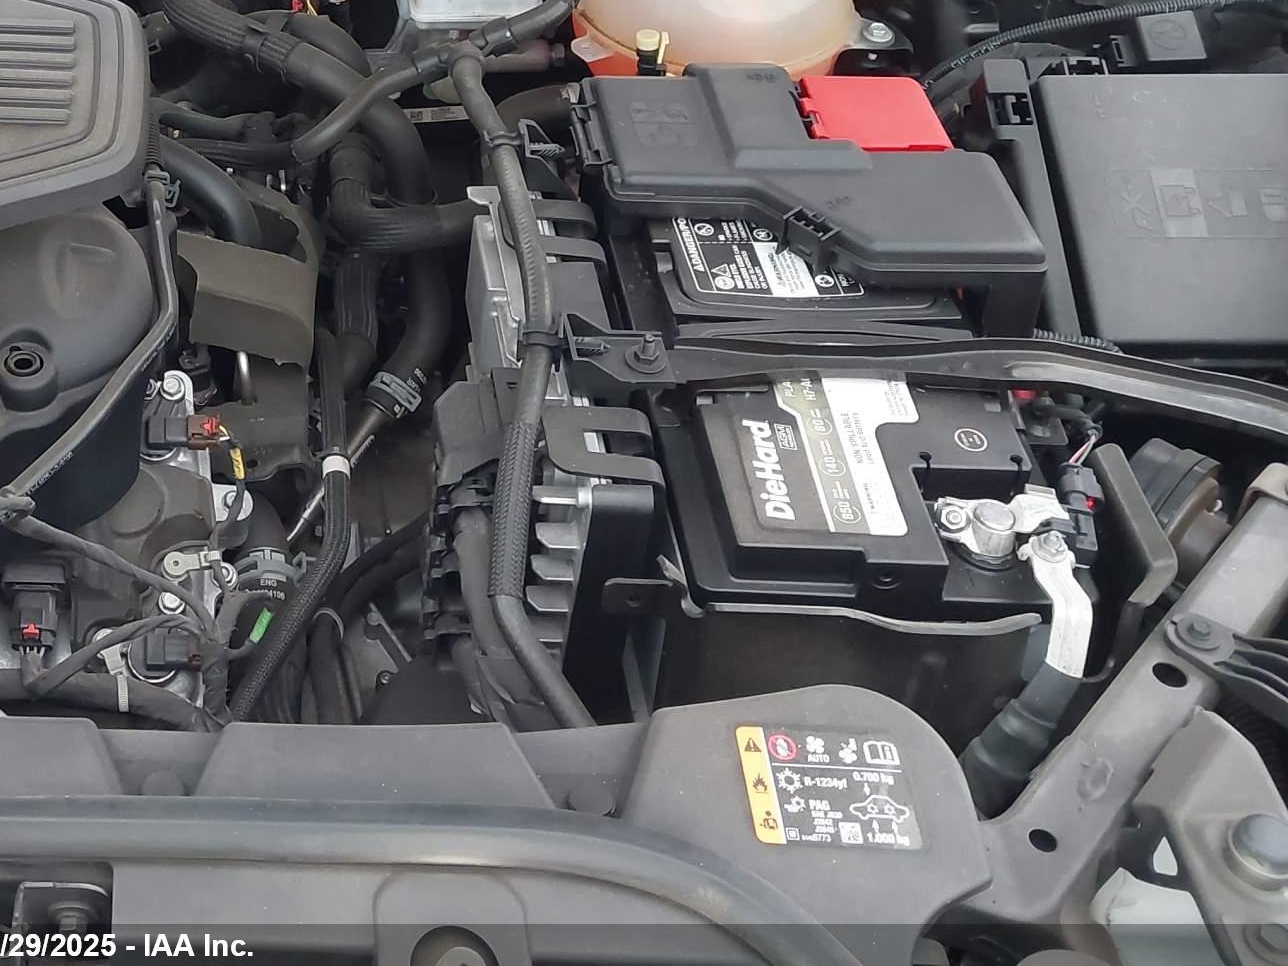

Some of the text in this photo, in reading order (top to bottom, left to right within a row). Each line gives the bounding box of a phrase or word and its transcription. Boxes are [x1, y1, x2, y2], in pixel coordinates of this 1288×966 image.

[812, 419, 827, 433] 80
[777, 425, 790, 448] AGM
[742, 419, 795, 521] DieHard
[823, 456, 840, 474] 140
[837, 500, 855, 521] 850
[807, 754, 830, 763] AUTO
[852, 771, 895, 786] 0.700 kg
[808, 799, 831, 811] PAG
[867, 832, 895, 843] 1.000
